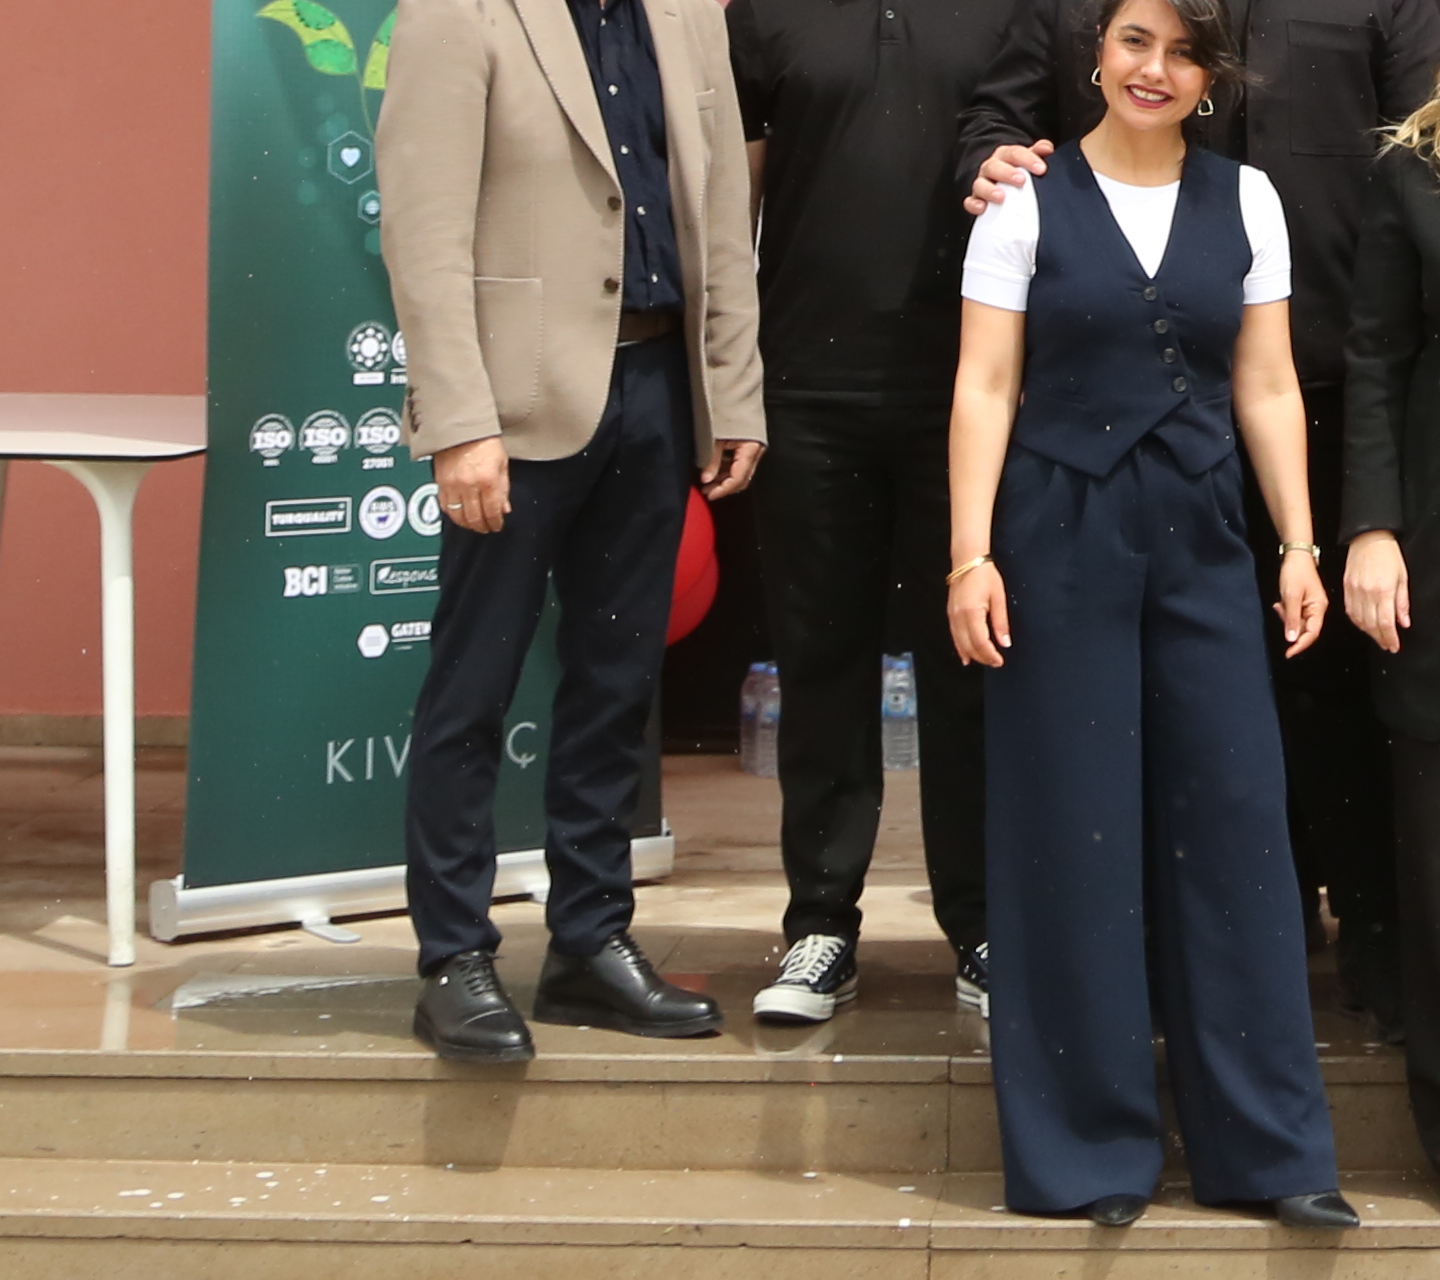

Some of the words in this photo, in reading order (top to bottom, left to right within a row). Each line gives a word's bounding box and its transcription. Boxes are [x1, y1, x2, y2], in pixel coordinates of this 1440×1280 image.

[252, 429, 293, 451] ISO
[303, 426, 348, 448] ISO
[358, 424, 401, 445] ISO
[283, 564, 328, 597] BCI
[376, 565, 439, 588] Respons
[391, 620, 433, 639] GATEW
[325, 721, 537, 785] KIVÇ
